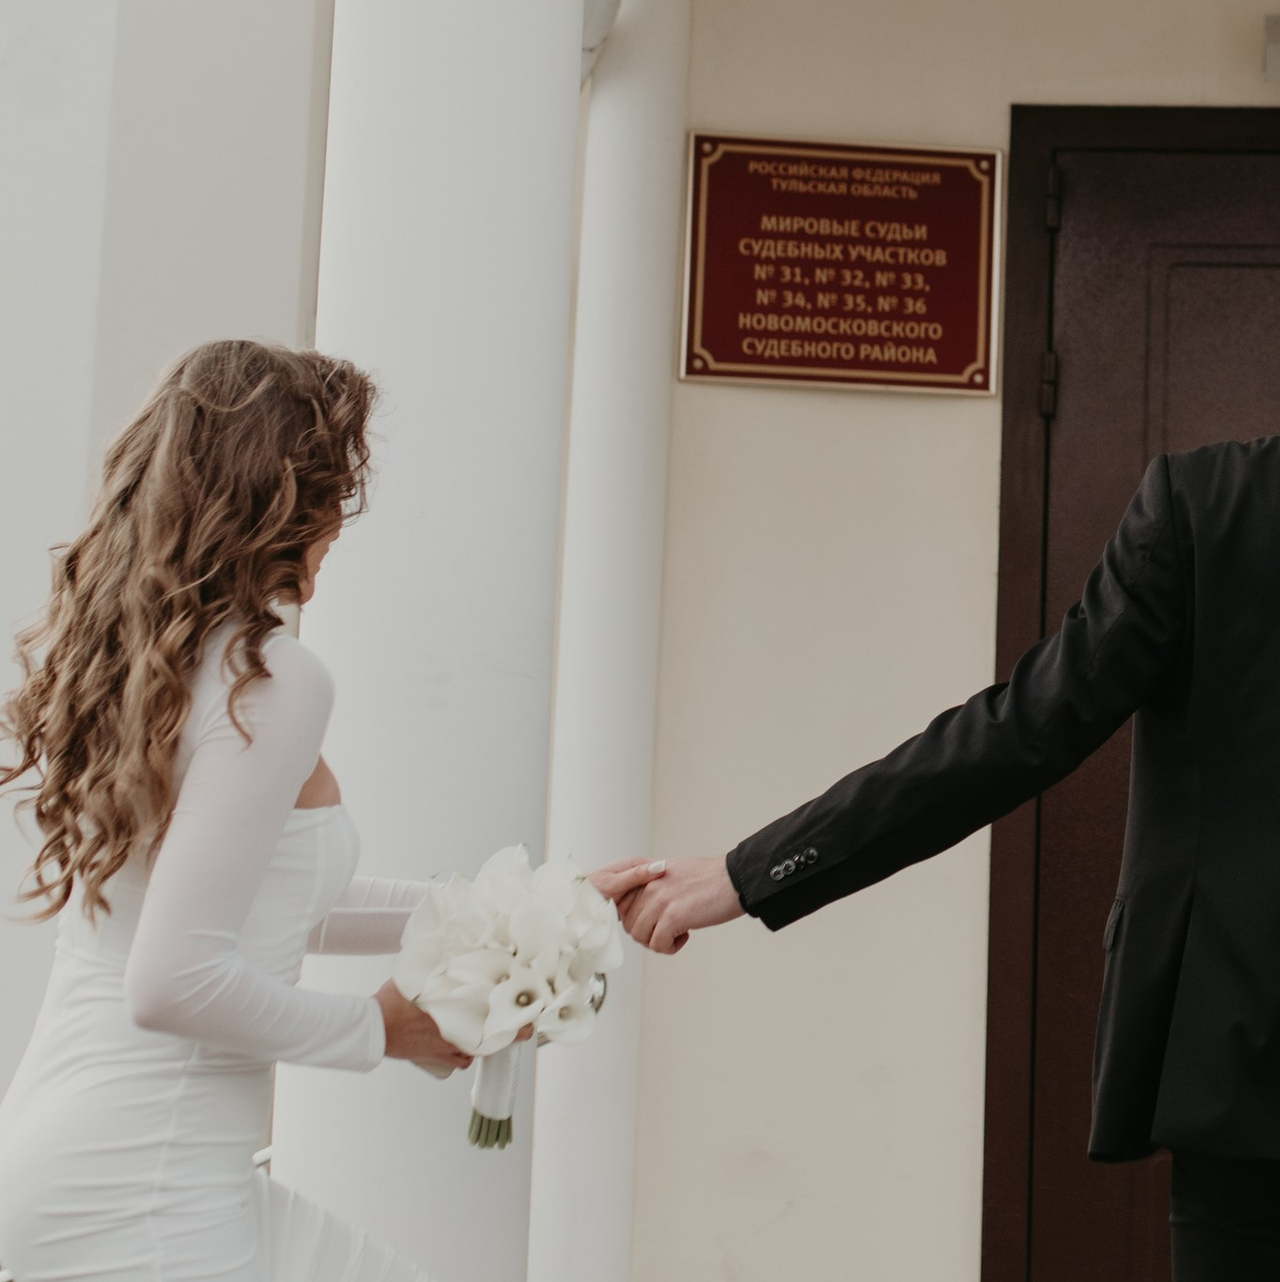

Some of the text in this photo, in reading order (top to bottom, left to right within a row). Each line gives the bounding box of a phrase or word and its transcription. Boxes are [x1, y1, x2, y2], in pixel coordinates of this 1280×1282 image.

[748, 159, 941, 186] РОССИЙСКАЯ ФЕДЕРАЦИЯ
[771, 177, 918, 200] ТУЛЬСКАЯ ОБЛАСТЬ
[760, 215, 927, 241] МИРОВЫЕ СУДЬИ
[738, 238, 947, 266] СУДЕБНЫХ УЧАСТКОВ
[781, 266, 809, 285] 31,
[840, 269, 870, 288] 32,
[901, 273, 931, 292] 33,
[782, 291, 811, 310] 34,
[843, 295, 873, 313] 35,
[903, 298, 926, 314] 36
[738, 313, 943, 340] НОВОМОСКОВСКОГО
[742, 337, 938, 364] СУДЕБНОГО РАЙОНА
